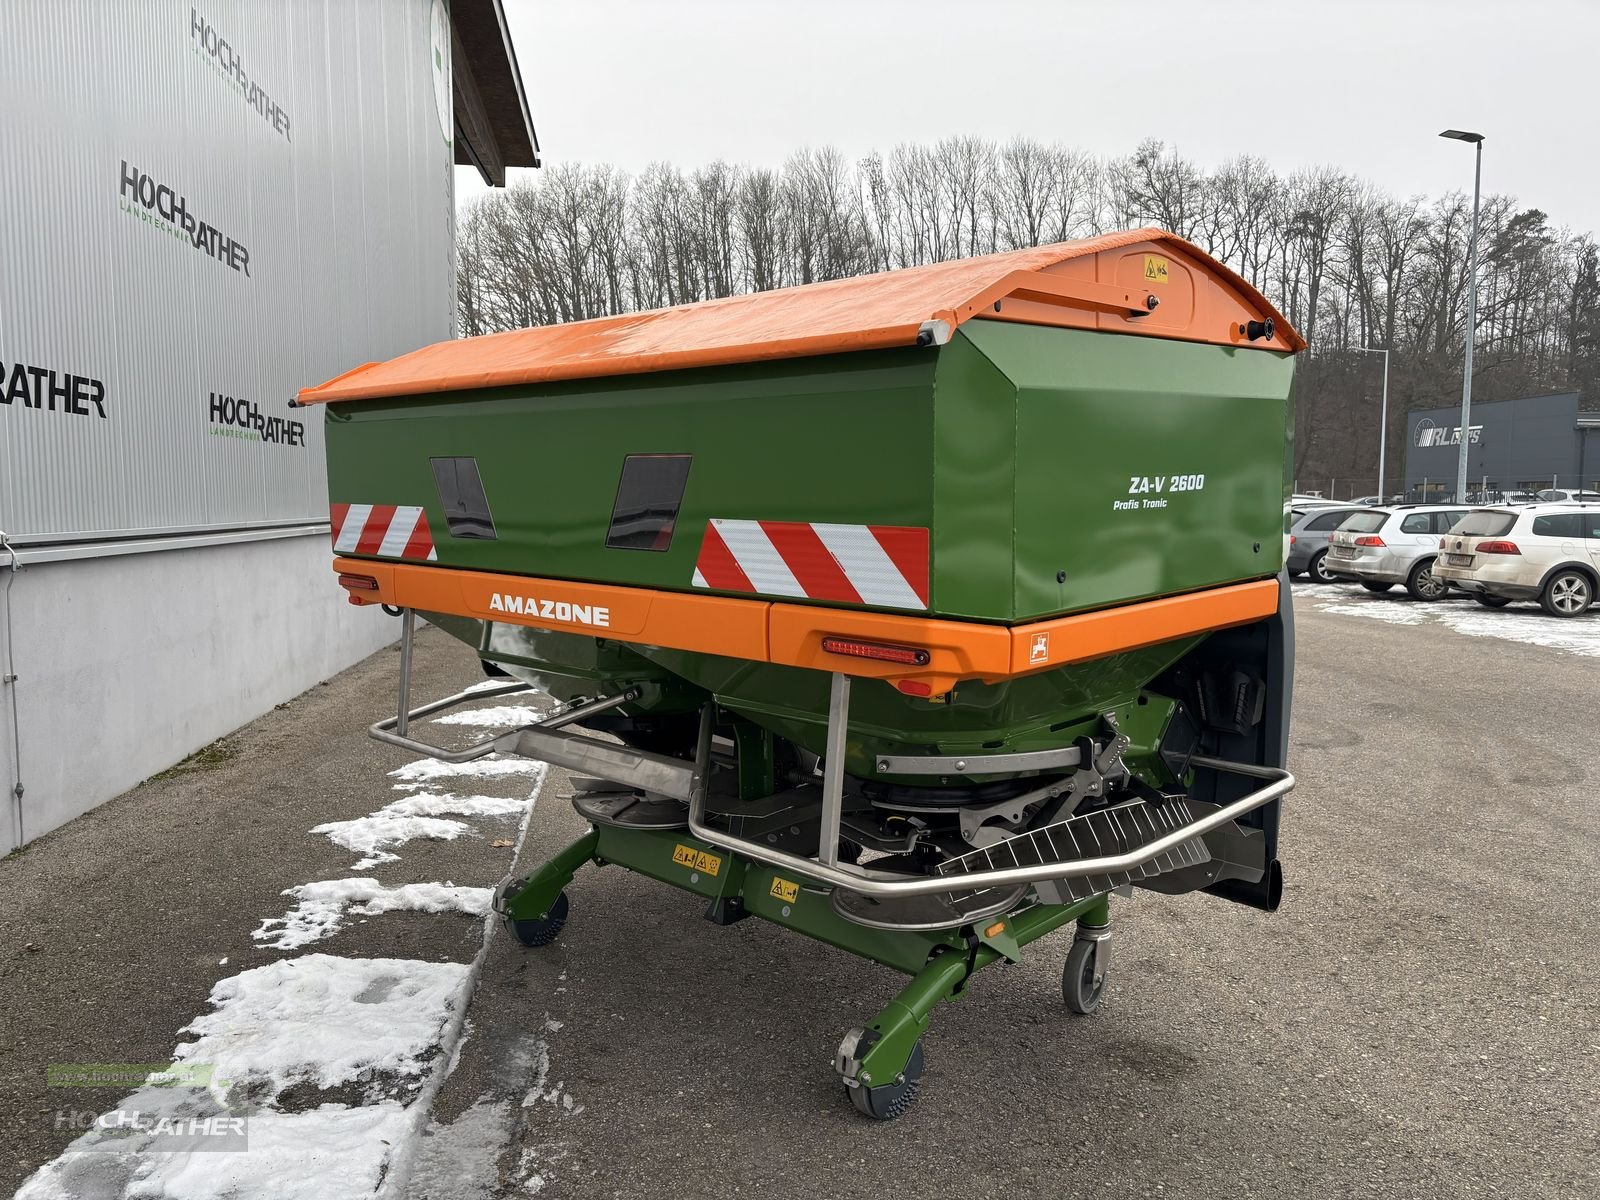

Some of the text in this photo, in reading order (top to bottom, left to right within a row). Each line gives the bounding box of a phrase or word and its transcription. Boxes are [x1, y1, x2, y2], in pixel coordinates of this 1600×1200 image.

[191, 6, 291, 143] HOCHRATHER
[120, 159, 250, 278] HOCHRATHER
[120, 199, 191, 244] LANDTECHNIK
[210, 392, 305, 447] HOCHRATHER
[1113, 498, 1168, 511] Profis Tronic
[1128, 474, 1205, 494] ZA-V 2600
[489, 592, 609, 627] AMAZONE
